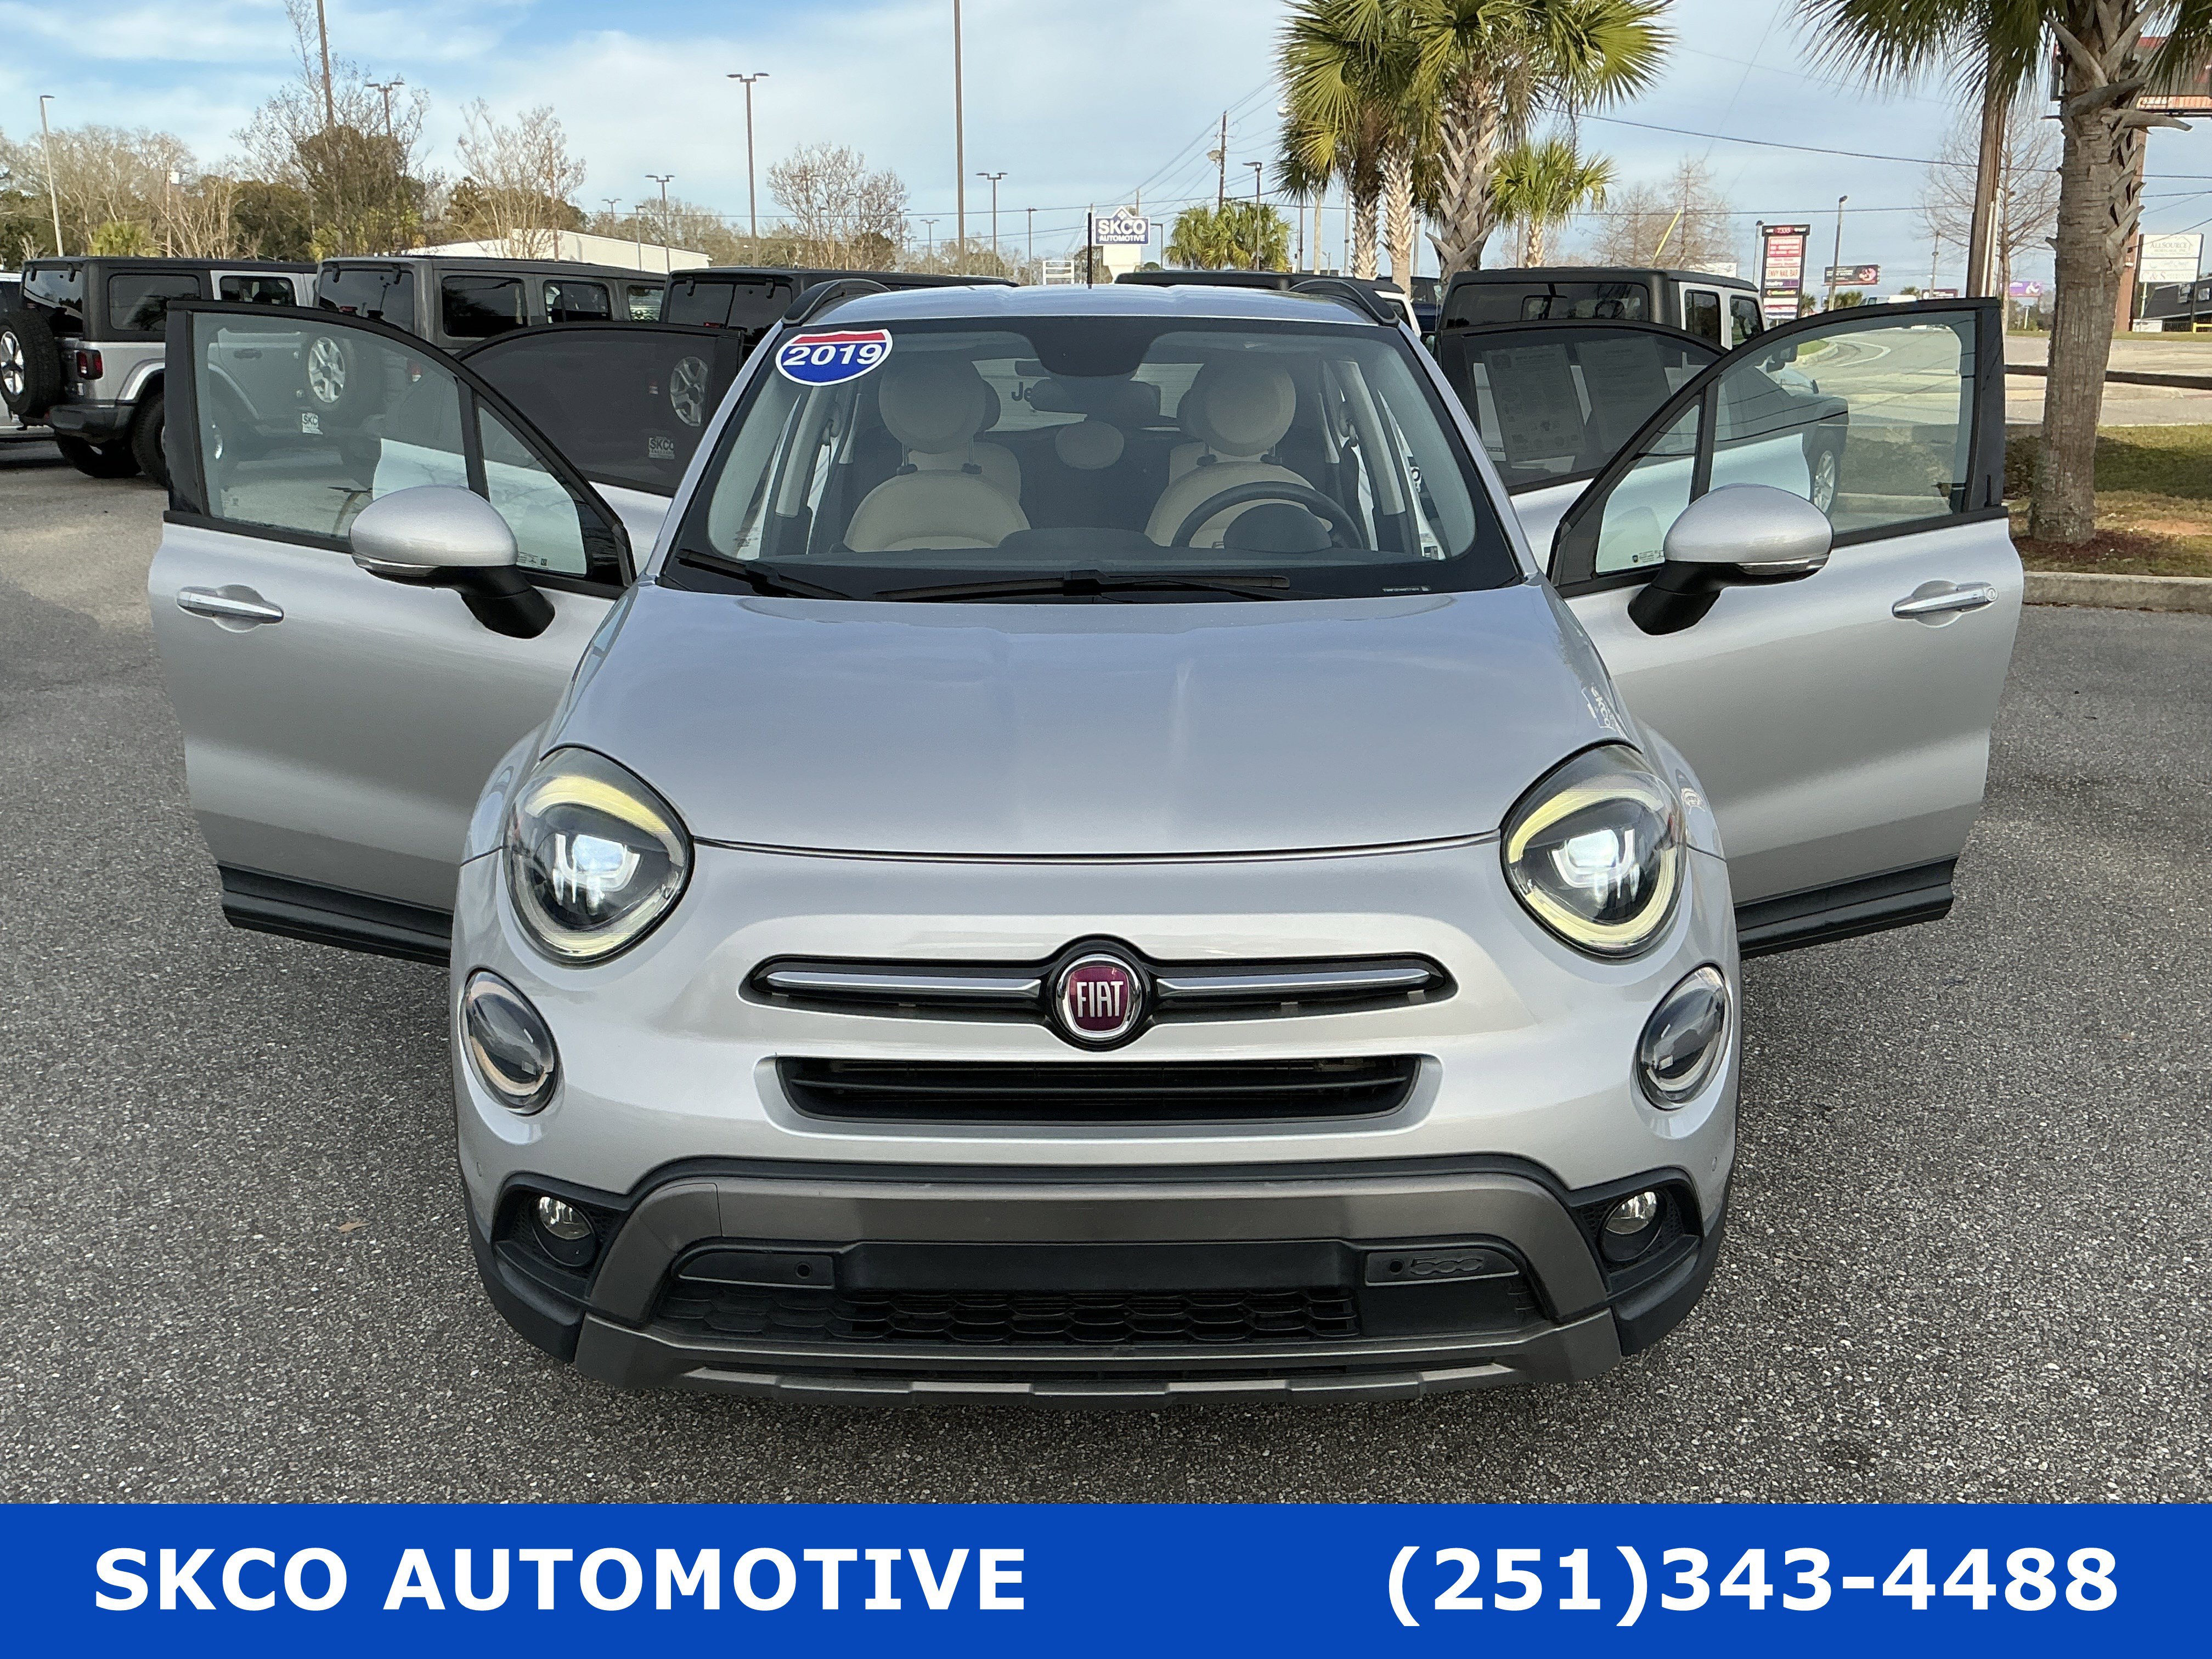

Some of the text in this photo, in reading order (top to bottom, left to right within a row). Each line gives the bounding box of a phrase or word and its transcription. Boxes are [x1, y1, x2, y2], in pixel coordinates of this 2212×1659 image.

[1098, 219, 1146, 235] SKCO
[782, 343, 882, 366] 2019
[1011, 381, 1032, 402] Je
[303, 414, 319, 425] SKC
[650, 438, 675, 450] SKCO
[1076, 980, 1124, 1018] FIAT
[1410, 1256, 1483, 1276] 500
